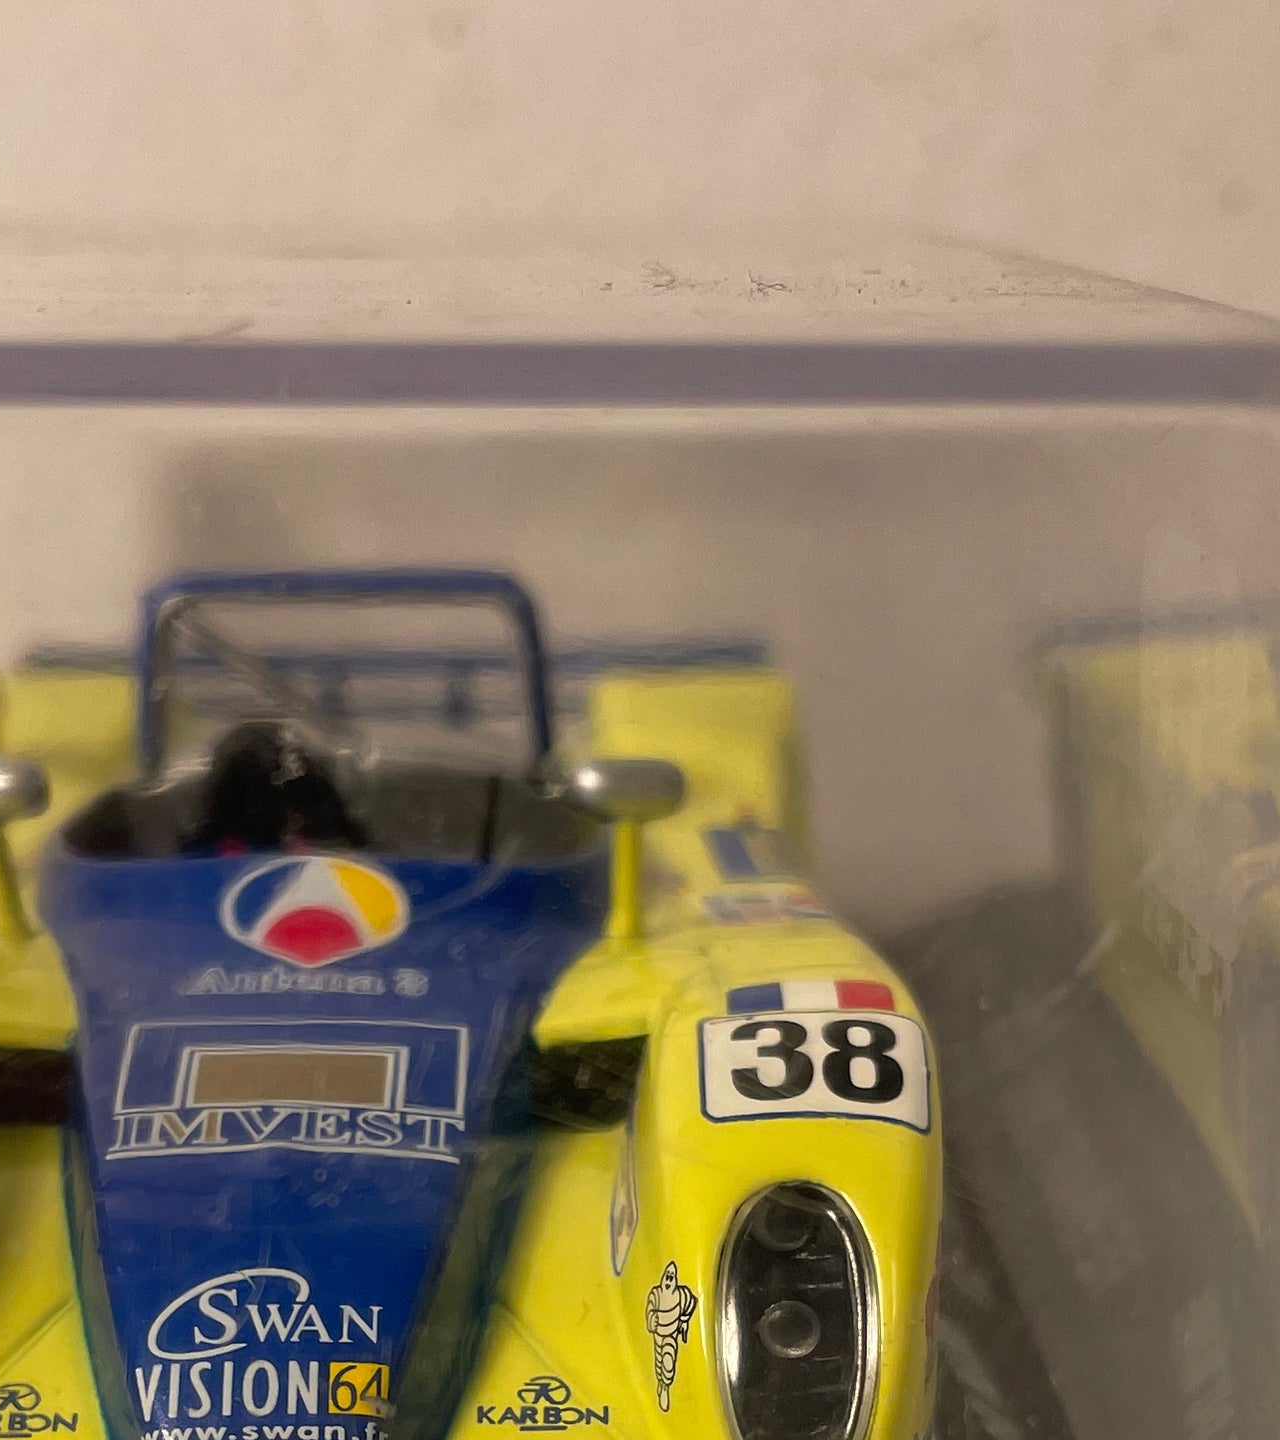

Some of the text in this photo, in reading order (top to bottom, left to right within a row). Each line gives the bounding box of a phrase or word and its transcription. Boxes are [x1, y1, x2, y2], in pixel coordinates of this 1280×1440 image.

[731, 1019, 904, 1103] 38
[135, 1359, 320, 1422] VISION
[476, 1405, 609, 1425] KARBON
